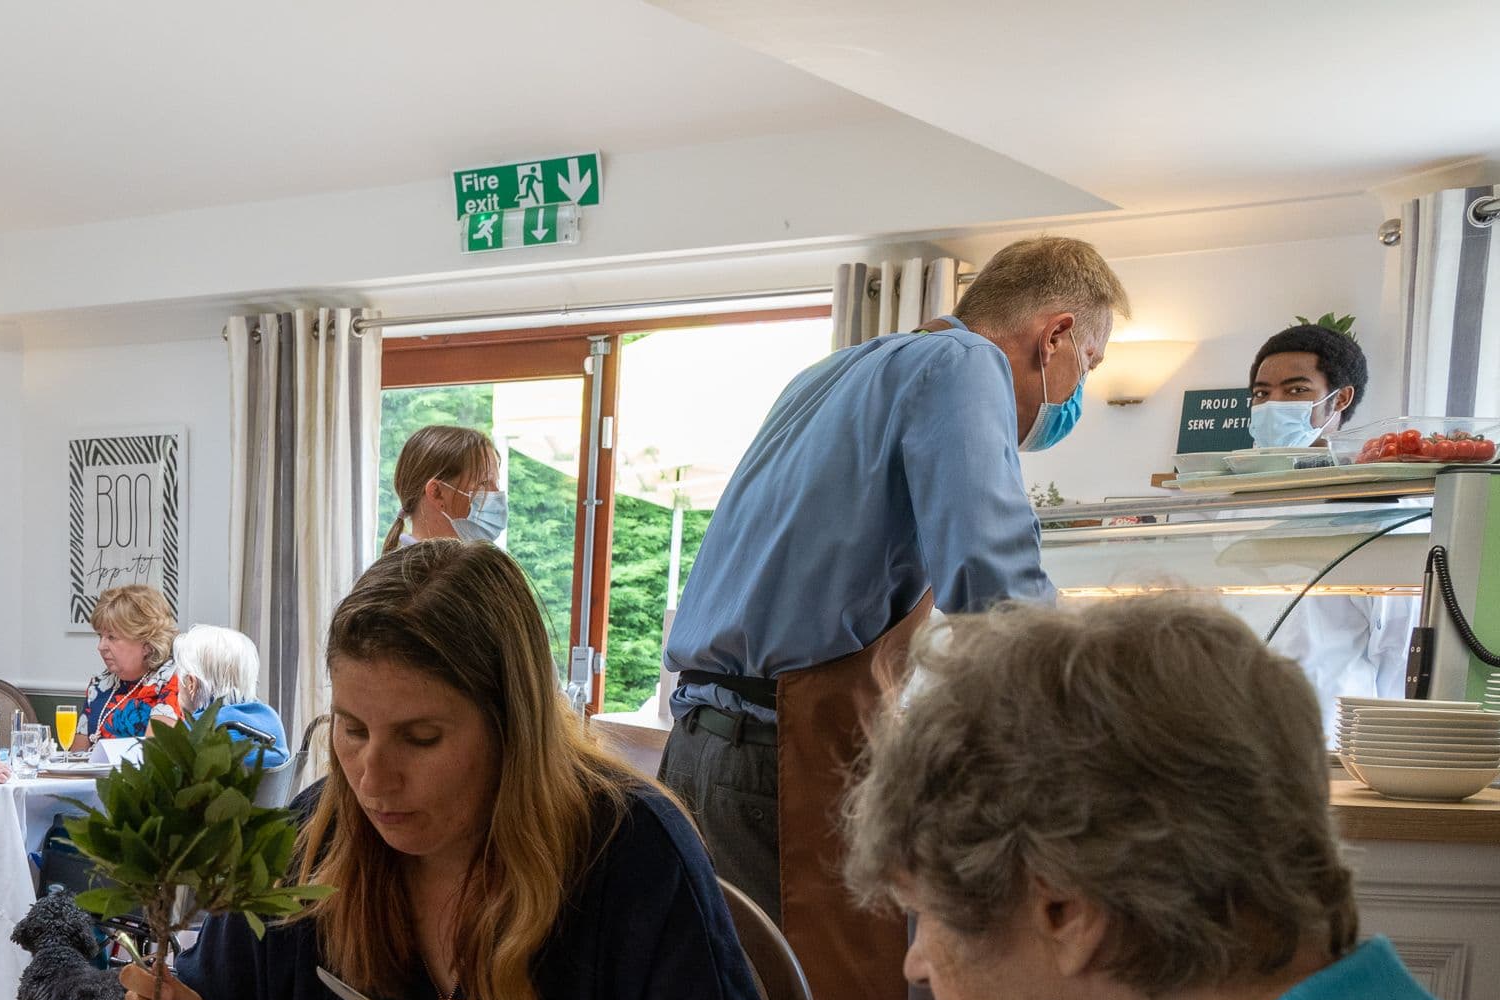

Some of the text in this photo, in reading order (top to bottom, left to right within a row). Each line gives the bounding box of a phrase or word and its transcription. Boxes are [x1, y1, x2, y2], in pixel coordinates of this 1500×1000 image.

[461, 173, 499, 192] Fire
[465, 193, 500, 214] exit
[1200, 397, 1252, 410] PROUD T
[1187, 417, 1250, 430] SERVE APETI
[97, 473, 152, 548] BON
